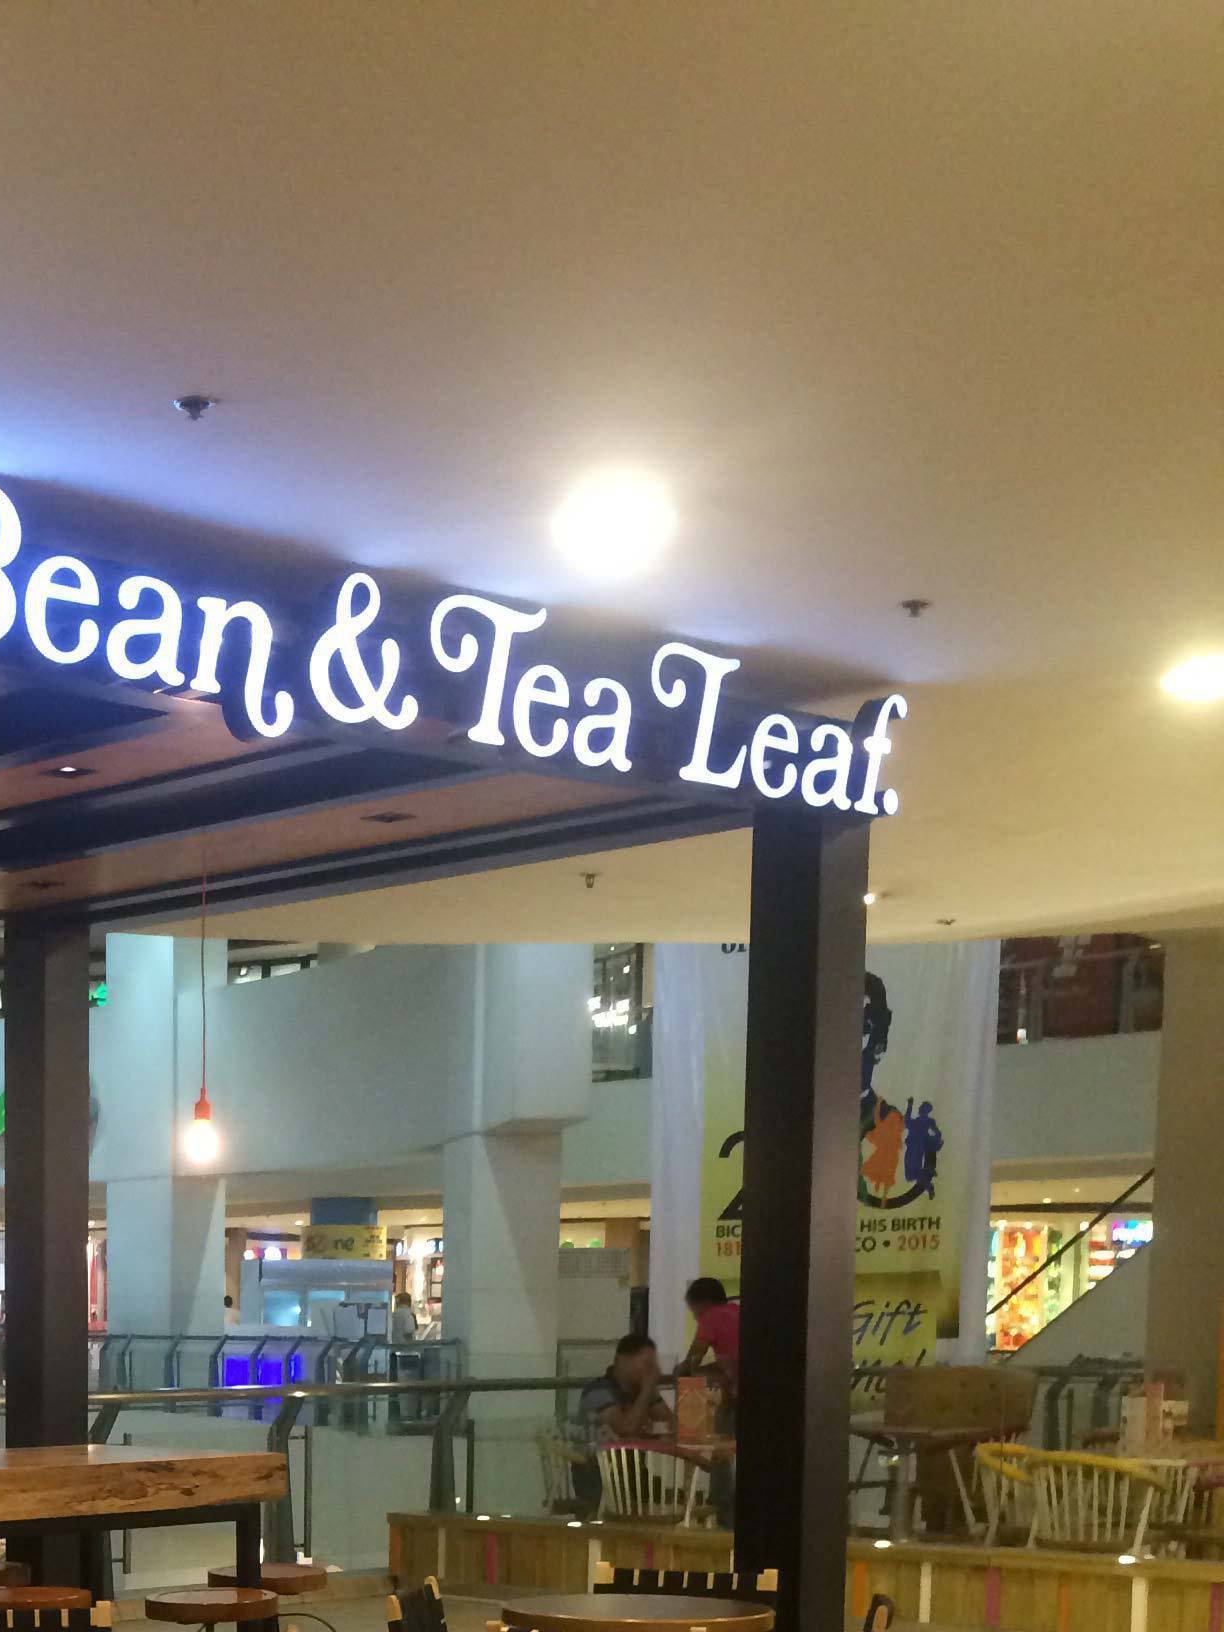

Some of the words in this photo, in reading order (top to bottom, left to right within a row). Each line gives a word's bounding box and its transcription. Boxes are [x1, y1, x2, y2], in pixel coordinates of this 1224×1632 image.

[310, 573, 418, 730] &
[431, 595, 633, 772] Tea
[859, 1217, 886, 1232] HIS
[891, 1216, 941, 1232] BIRTH
[897, 1233, 939, 1251] 2015
